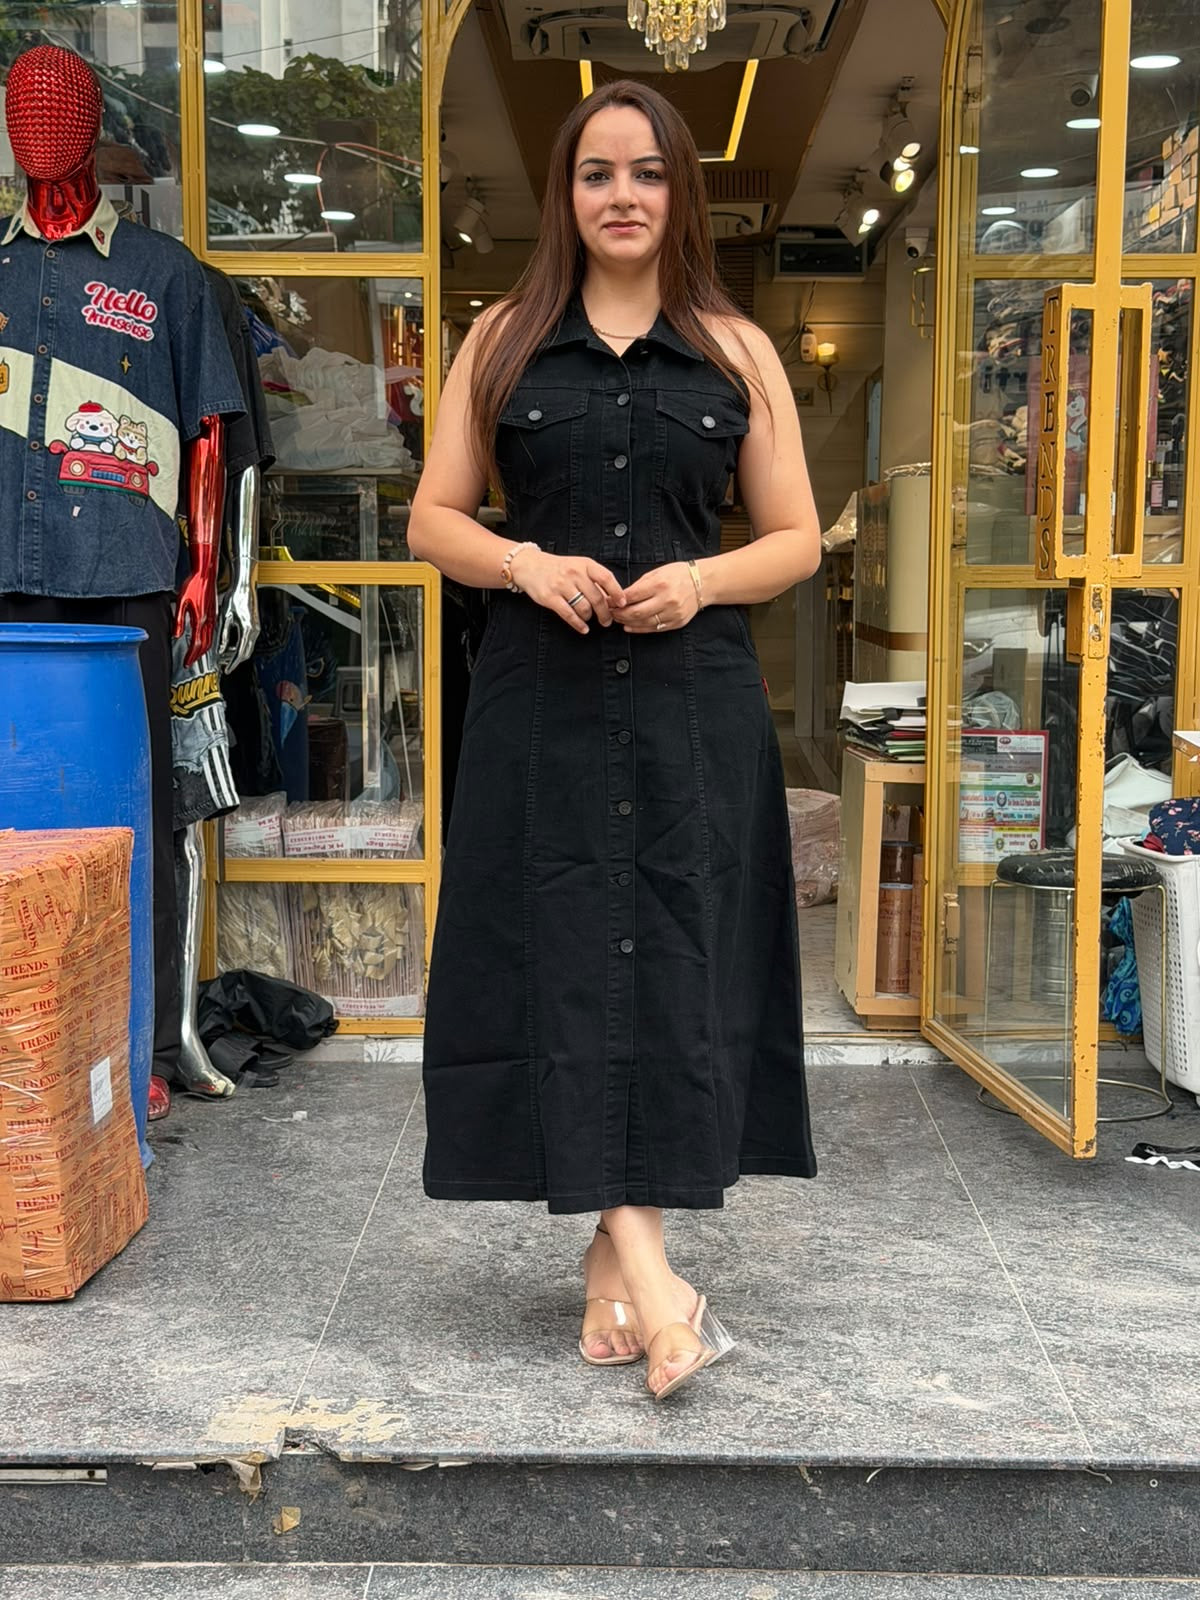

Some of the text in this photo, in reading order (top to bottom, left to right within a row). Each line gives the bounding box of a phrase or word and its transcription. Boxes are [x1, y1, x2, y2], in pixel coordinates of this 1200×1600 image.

[84, 281, 157, 323] Hello
[1039, 296, 1058, 571] TRENDS
[2, 960, 48, 976] TRENDS
[19, 1031, 60, 1050] TRENDS
